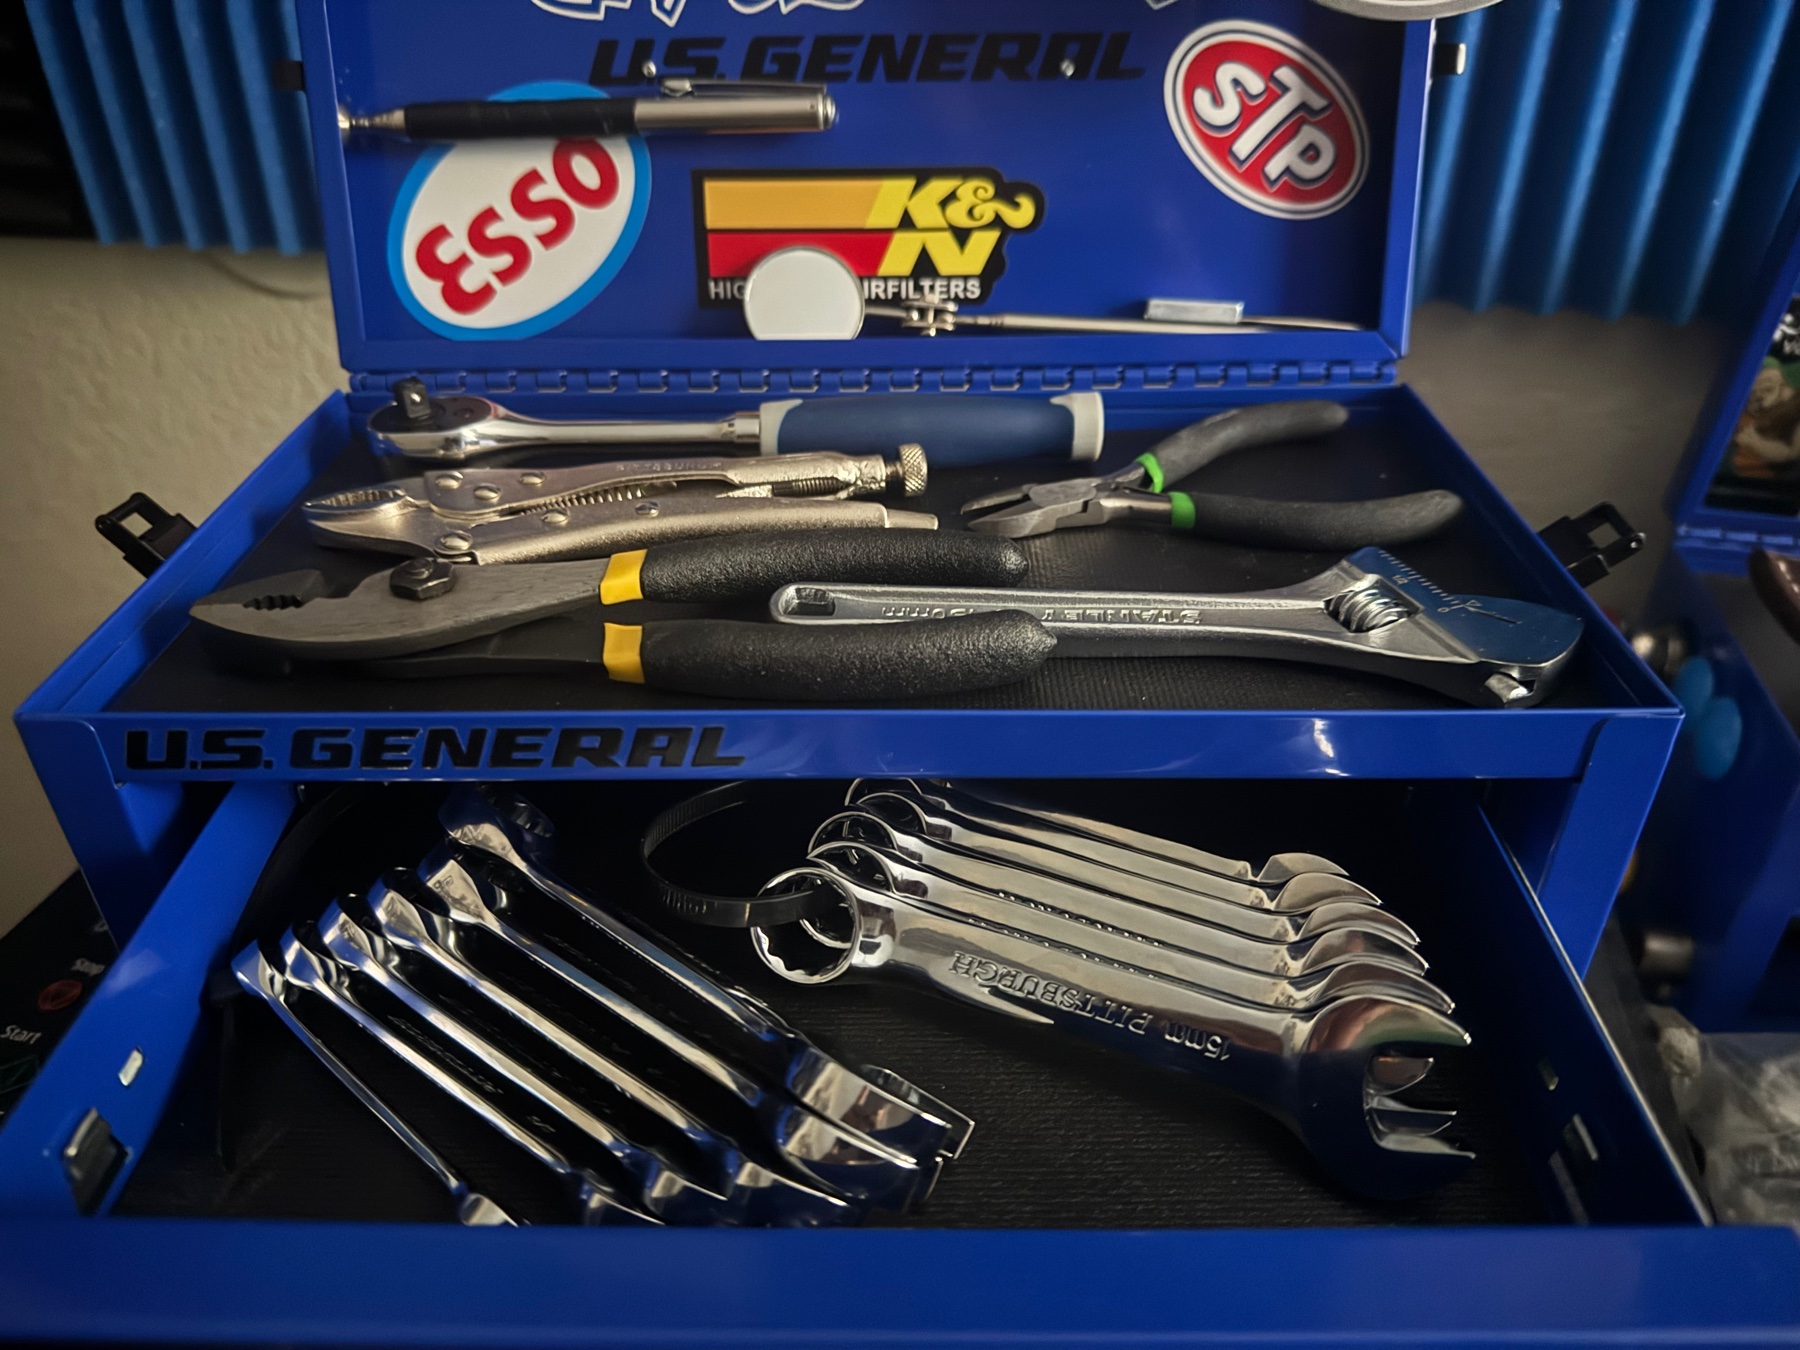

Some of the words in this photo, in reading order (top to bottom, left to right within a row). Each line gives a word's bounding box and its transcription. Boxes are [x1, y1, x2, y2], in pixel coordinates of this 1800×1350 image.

[588, 37, 727, 86] U.S.
[740, 32, 1146, 82] GENERAL
[1192, 60, 1338, 188] STP
[864, 278, 981, 300] IRFILTERS
[1041, 608, 1202, 625] STANLEY
[125, 729, 274, 770] U.S.
[289, 726, 746, 770] GENERAL
[948, 952, 1154, 1036] PITTSBURGH
[0, 1024, 42, 1045] Start
[1160, 1019, 1231, 1061] 15mm
